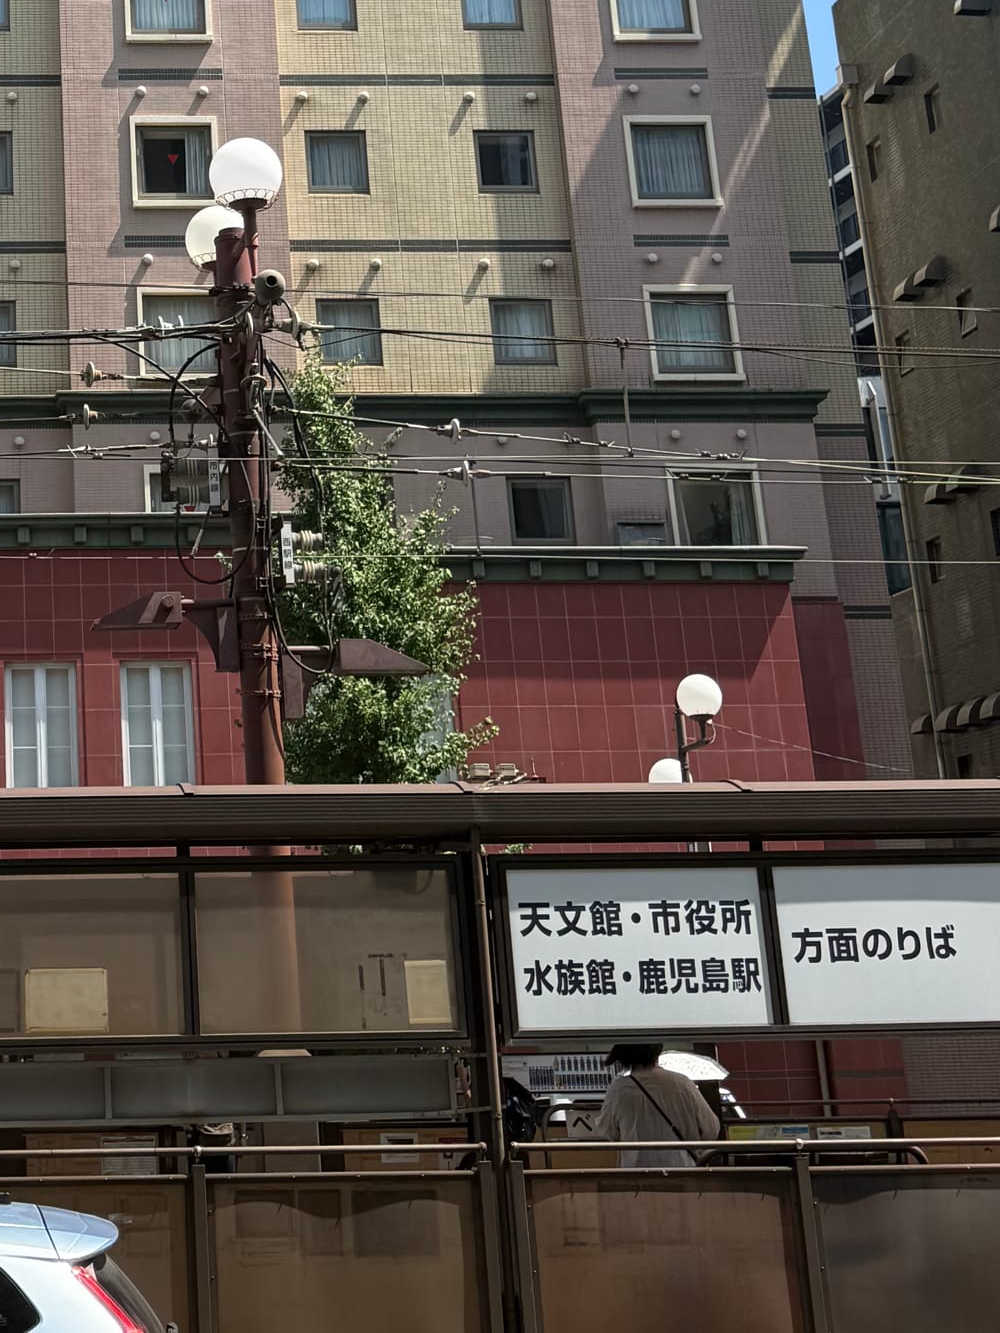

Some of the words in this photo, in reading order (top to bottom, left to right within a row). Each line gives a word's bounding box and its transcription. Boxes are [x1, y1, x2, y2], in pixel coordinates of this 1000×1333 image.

[518, 899, 752, 937] 天文館・市役所
[791, 924, 957, 964] 方面のりば
[523, 957, 762, 996] 水族館・鹿児島駅
